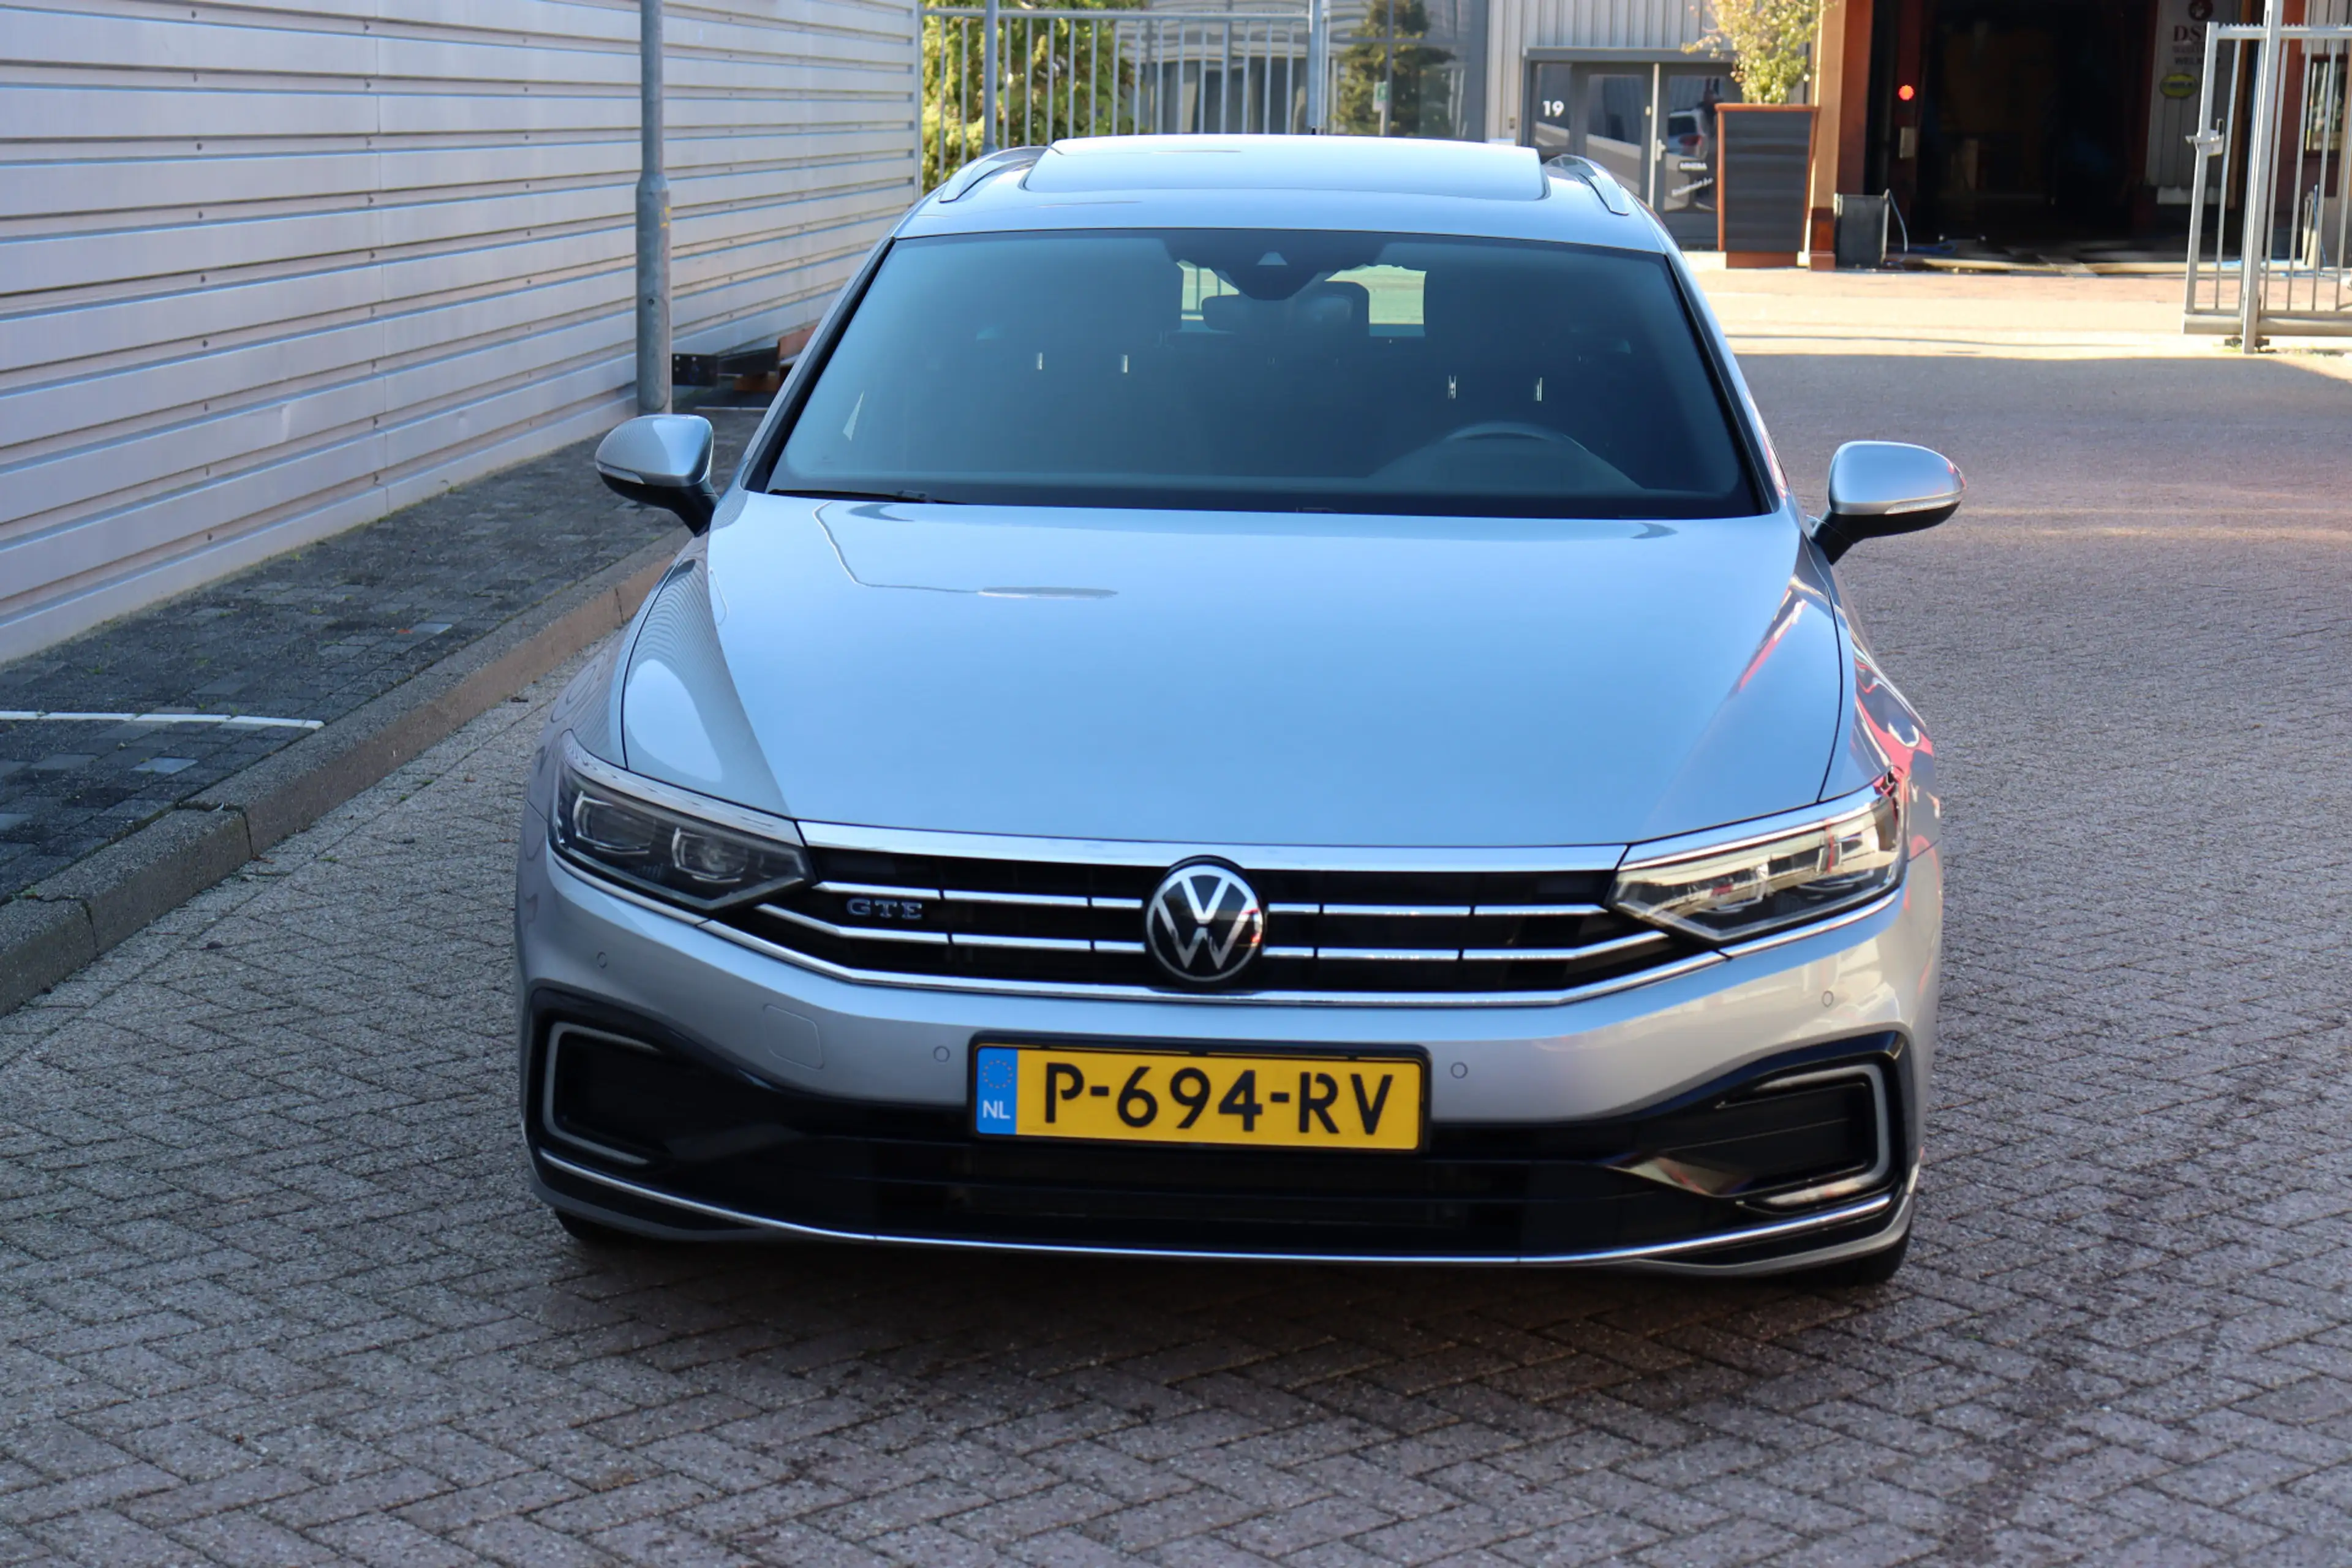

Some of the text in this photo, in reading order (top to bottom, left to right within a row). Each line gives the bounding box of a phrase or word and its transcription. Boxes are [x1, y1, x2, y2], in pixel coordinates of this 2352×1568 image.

[1542, 100, 1565, 118] 19
[846, 898, 922, 919] GTE
[1044, 1061, 1393, 1136] P-694-RV
[982, 1099, 1011, 1120] NL
